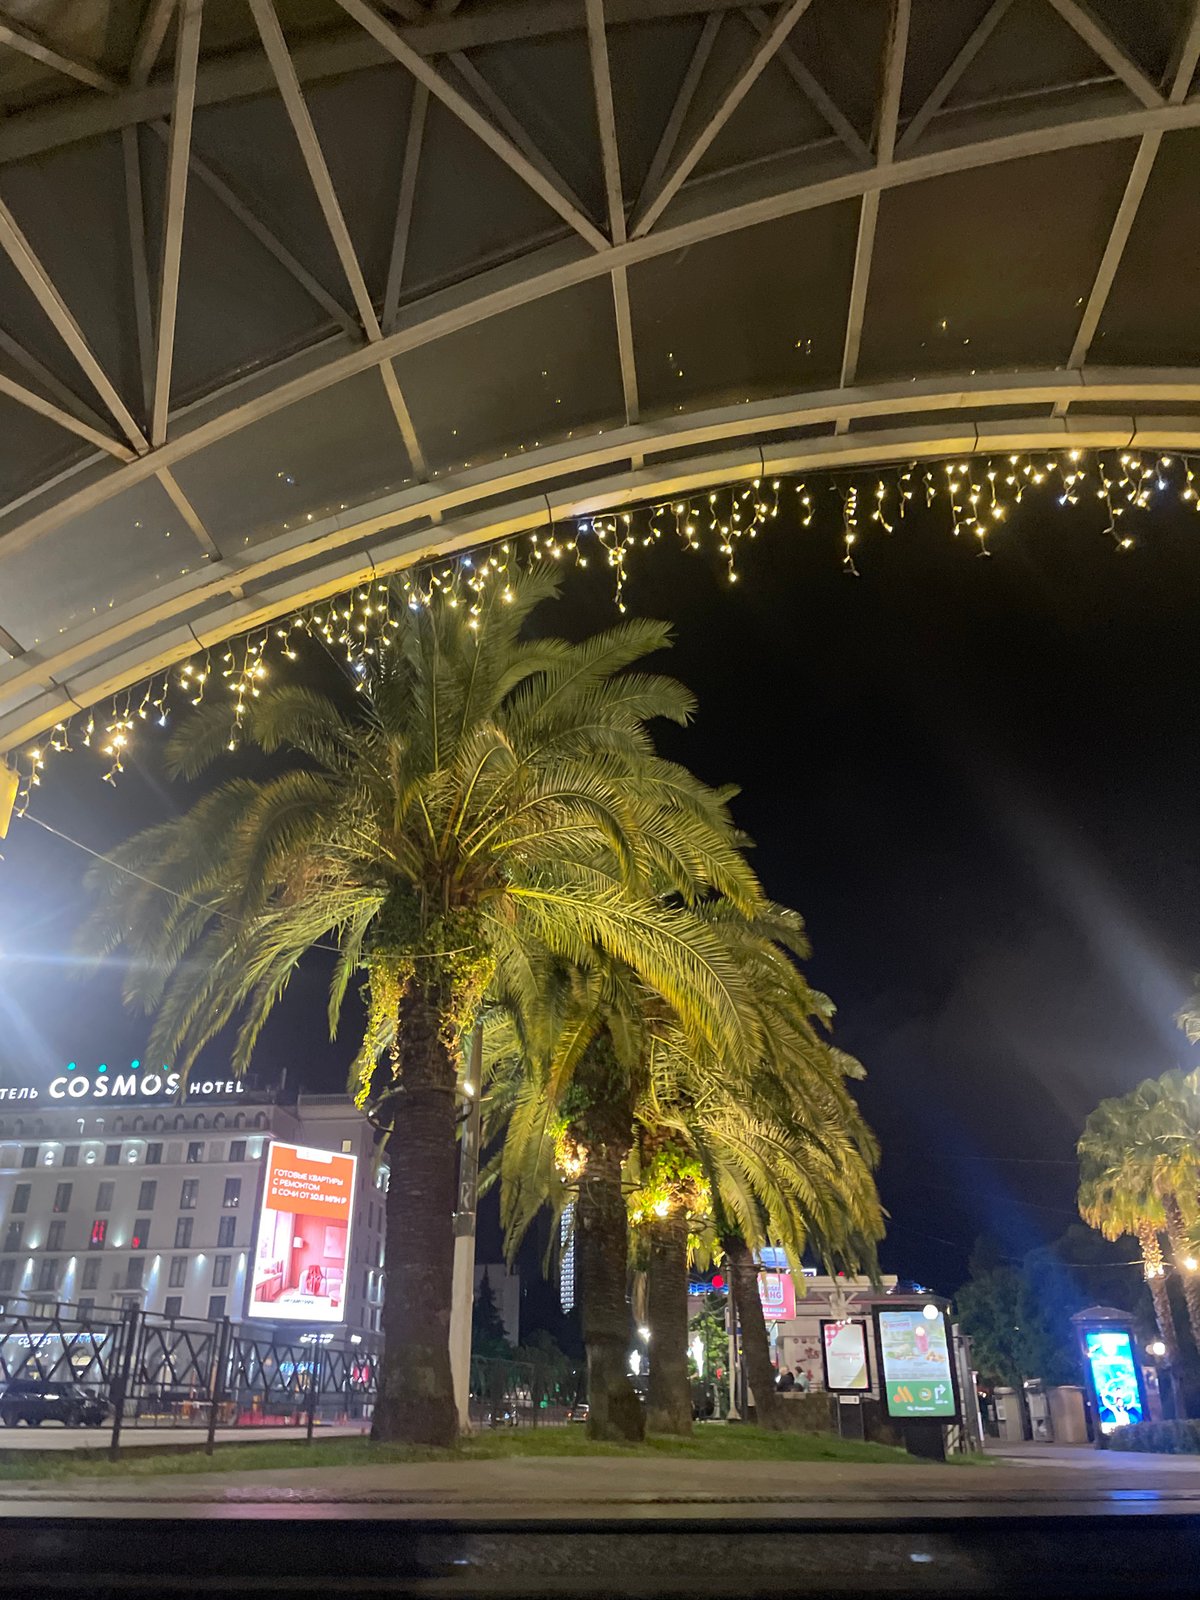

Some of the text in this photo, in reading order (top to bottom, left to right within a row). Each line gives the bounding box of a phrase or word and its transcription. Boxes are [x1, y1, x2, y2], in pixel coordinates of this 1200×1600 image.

[49, 1073, 244, 1099] COSMOS HOTEL
[274, 1168, 344, 1186] ГОТОВЫЕ КВАРТИРЫ
[280, 1179, 320, 1191] РЕМОНТОМ
[278, 1188, 299, 1198] СОЧИ
[299, 1191, 310, 1199] ОТ
